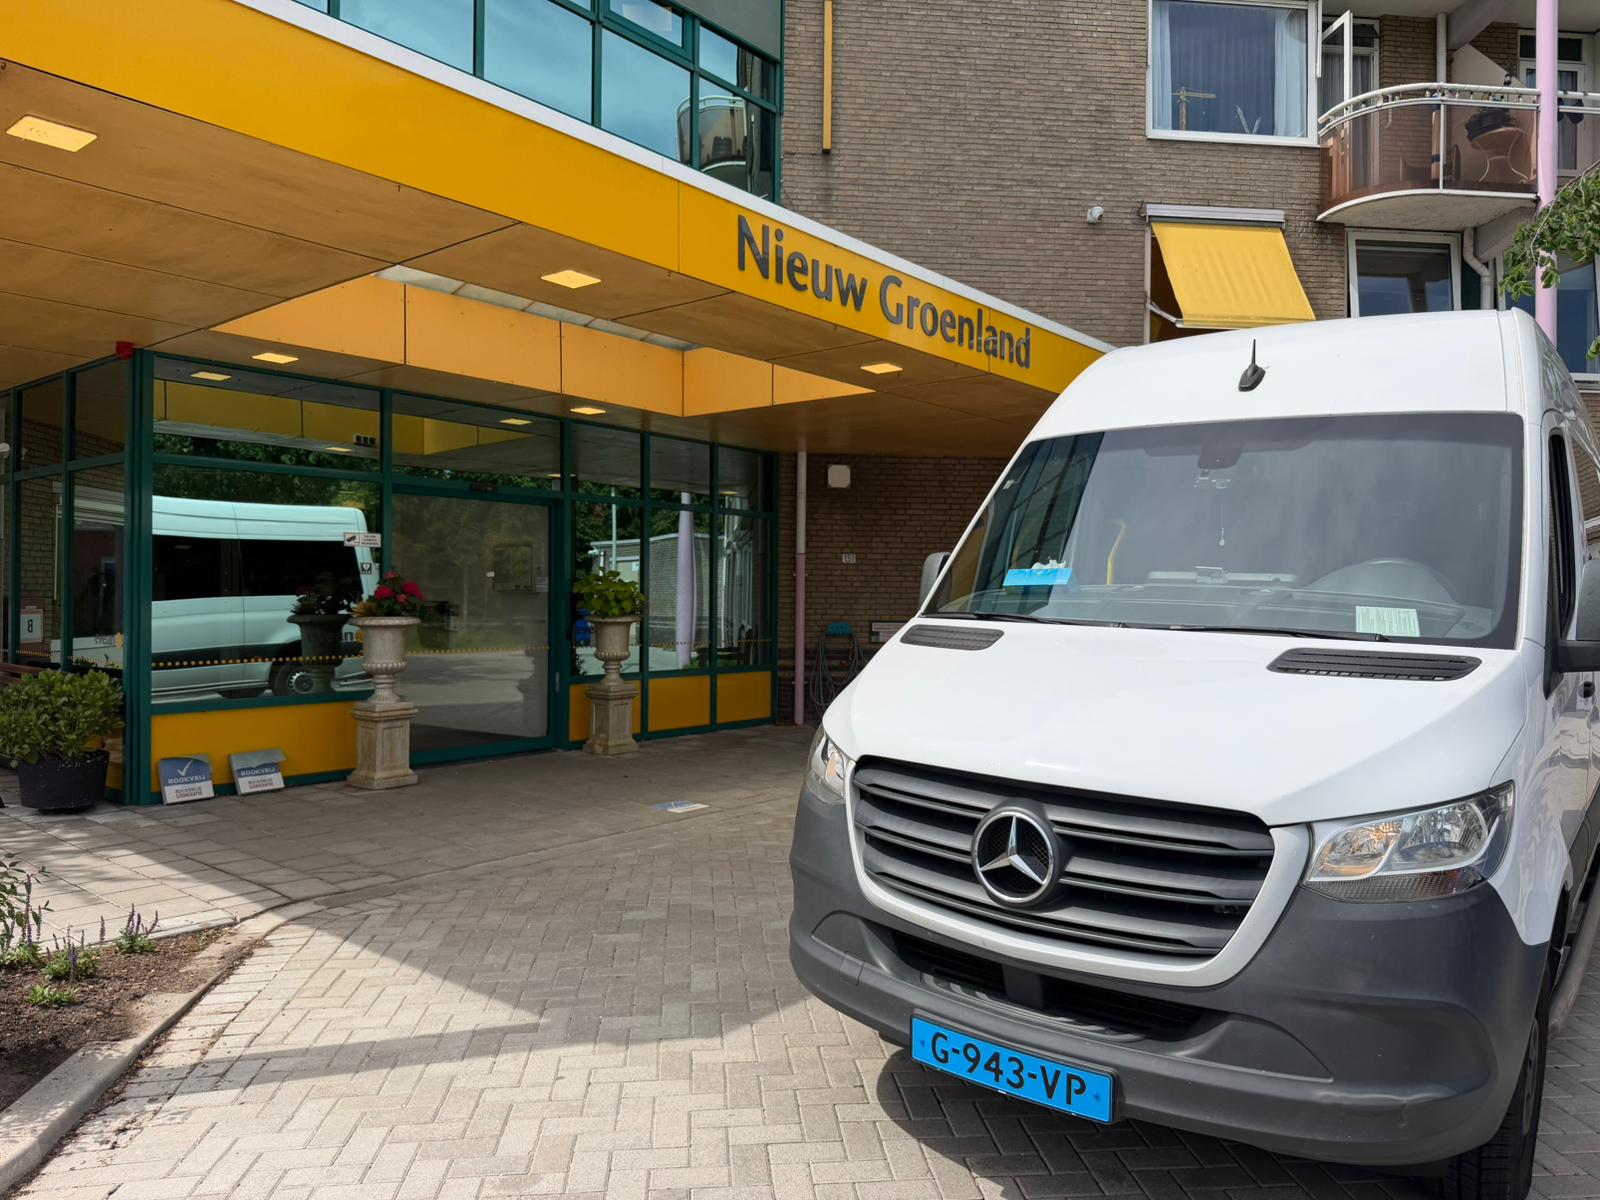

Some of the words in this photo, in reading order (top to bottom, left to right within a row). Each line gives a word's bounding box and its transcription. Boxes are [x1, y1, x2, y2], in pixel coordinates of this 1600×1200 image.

[737, 214, 867, 312] Nieuw
[879, 275, 1031, 369] Groenland
[167, 774, 206, 784] ROOKVRIJ
[931, 1031, 1086, 1105] G-943-VP
